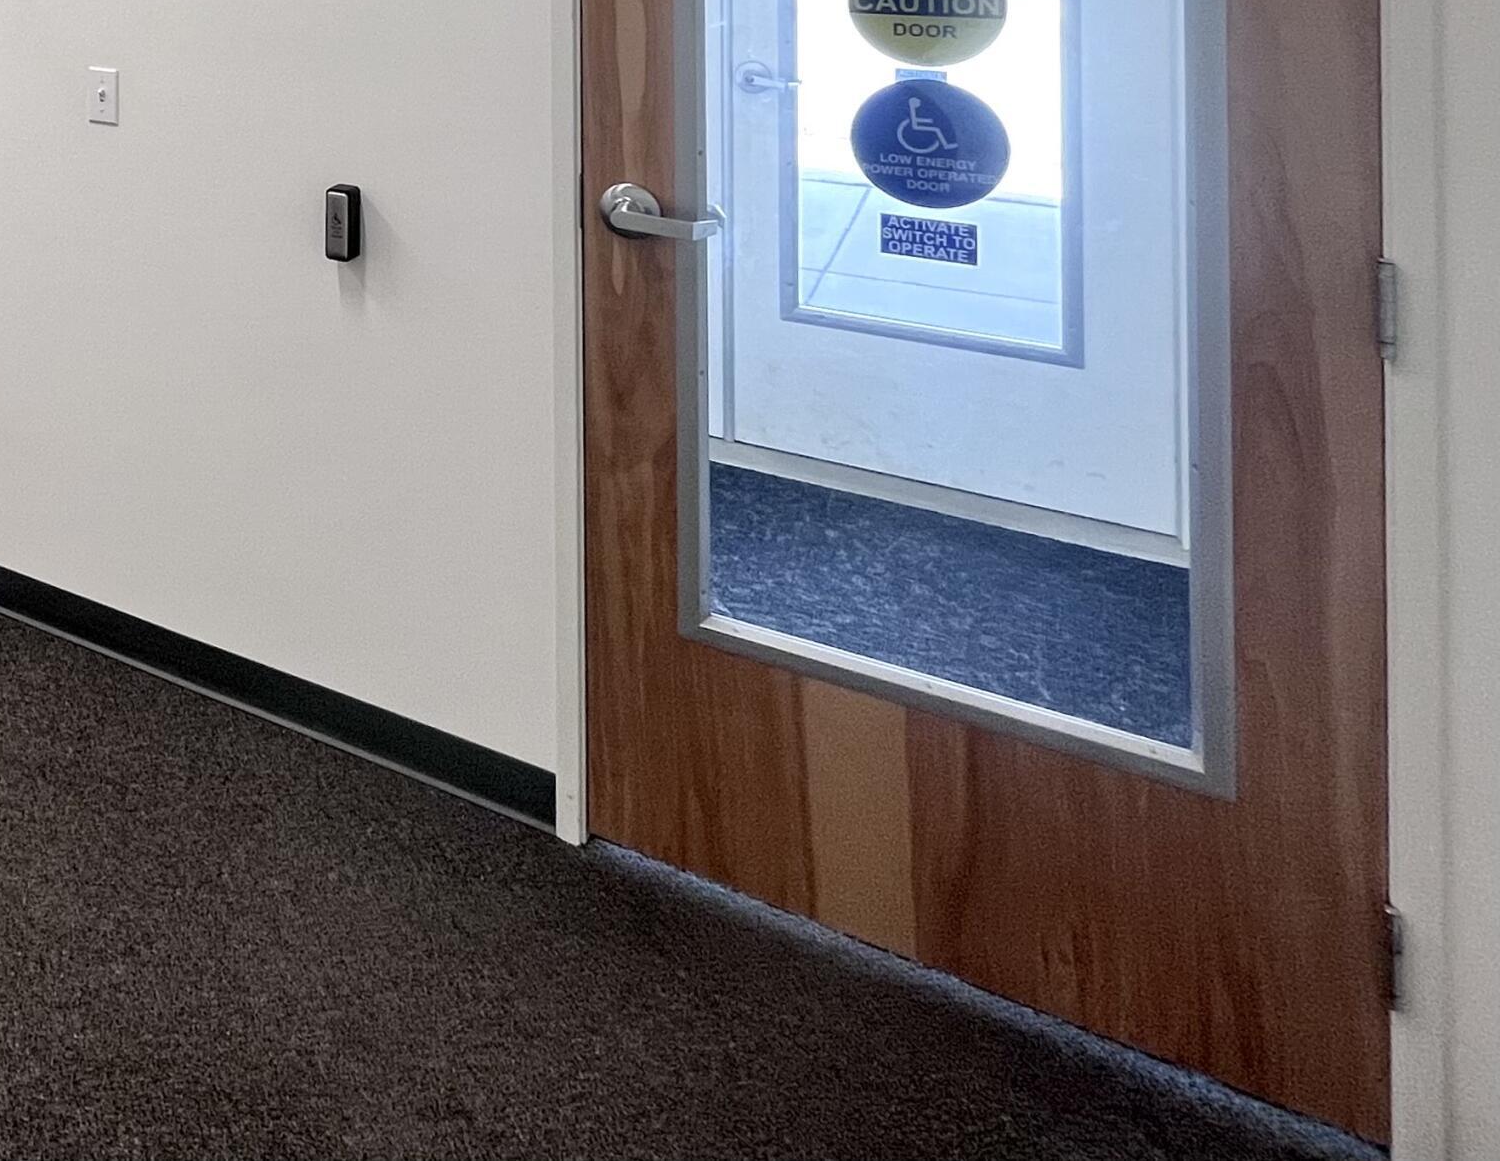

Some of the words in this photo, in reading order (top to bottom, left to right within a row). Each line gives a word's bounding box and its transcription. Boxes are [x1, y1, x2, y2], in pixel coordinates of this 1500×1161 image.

[893, 23, 957, 38] DOOR
[880, 153, 913, 165] LOW
[916, 156, 977, 171] ENERGY
[863, 163, 913, 177] POWER
[917, 168, 999, 185] OPERATED
[906, 179, 950, 192] DOOR
[887, 215, 969, 237] ACTIVATE
[882, 227, 947, 247] SWITCH
[953, 237, 976, 250] TO
[888, 241, 969, 263] OPERATE
